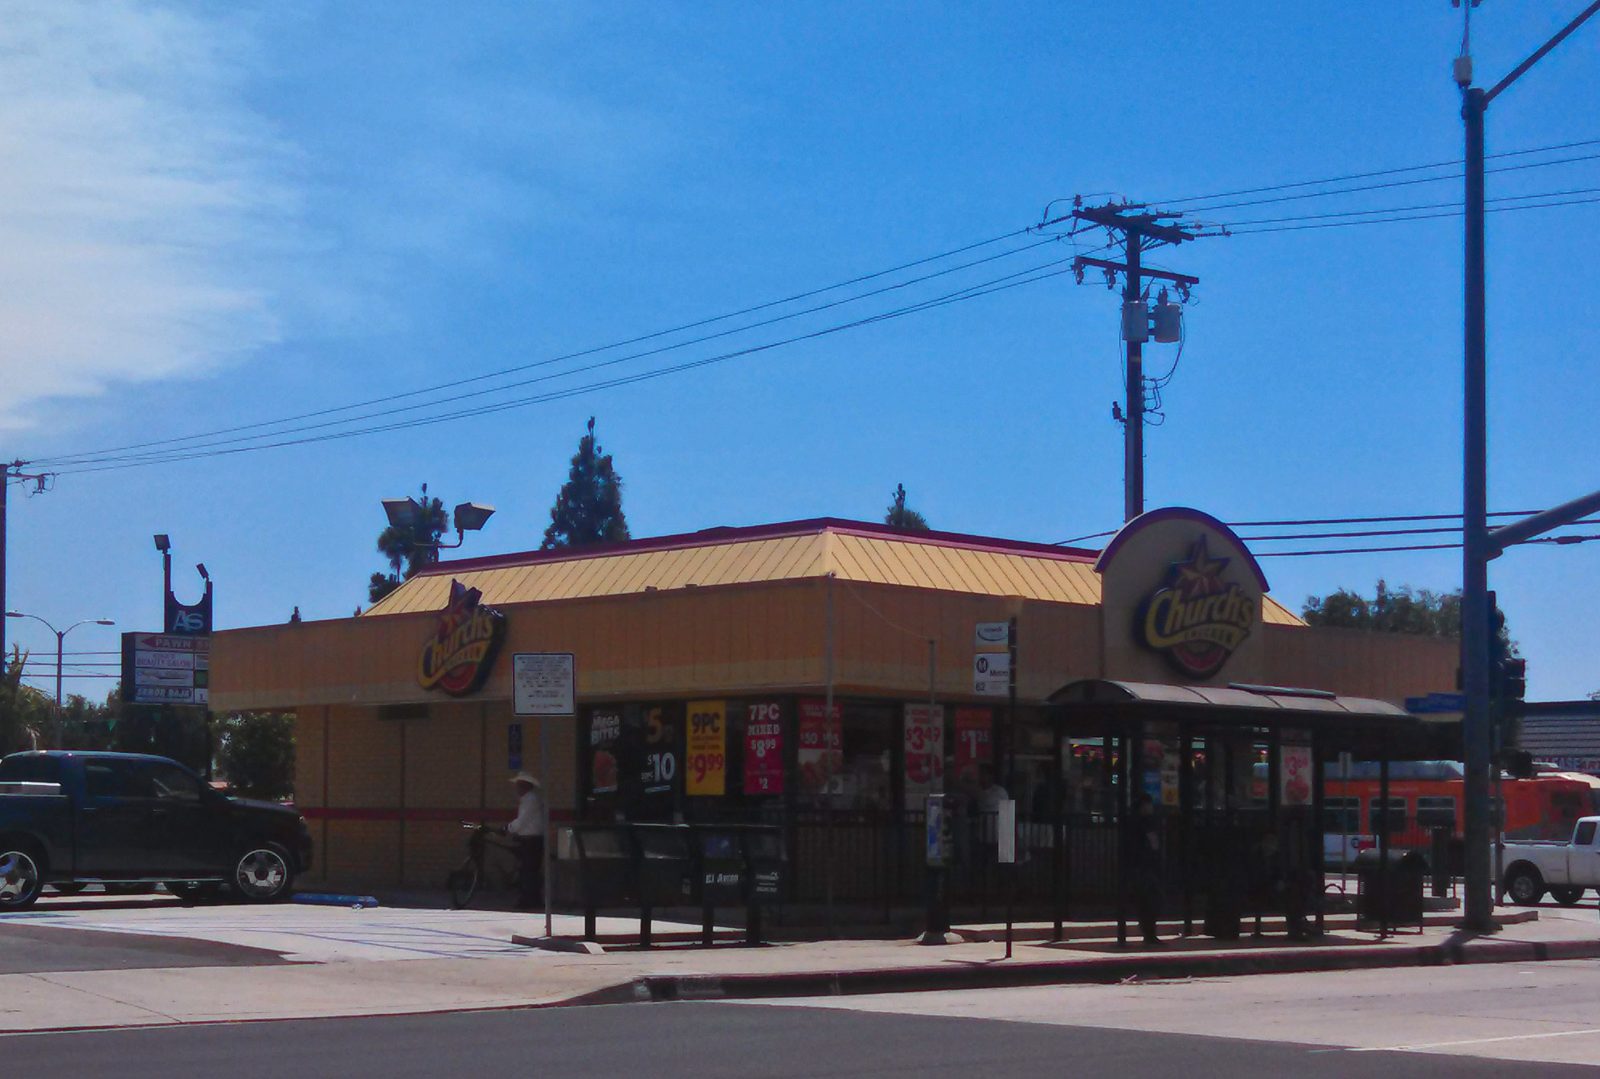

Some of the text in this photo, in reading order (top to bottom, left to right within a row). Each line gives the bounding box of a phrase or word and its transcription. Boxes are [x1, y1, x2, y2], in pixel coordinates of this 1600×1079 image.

[1144, 584, 1254, 648] Church's
[154, 638, 191, 649] PAWN
[748, 703, 780, 721] 7PC
[692, 712, 720, 734] 9PC
[747, 723, 780, 736] MIXED
